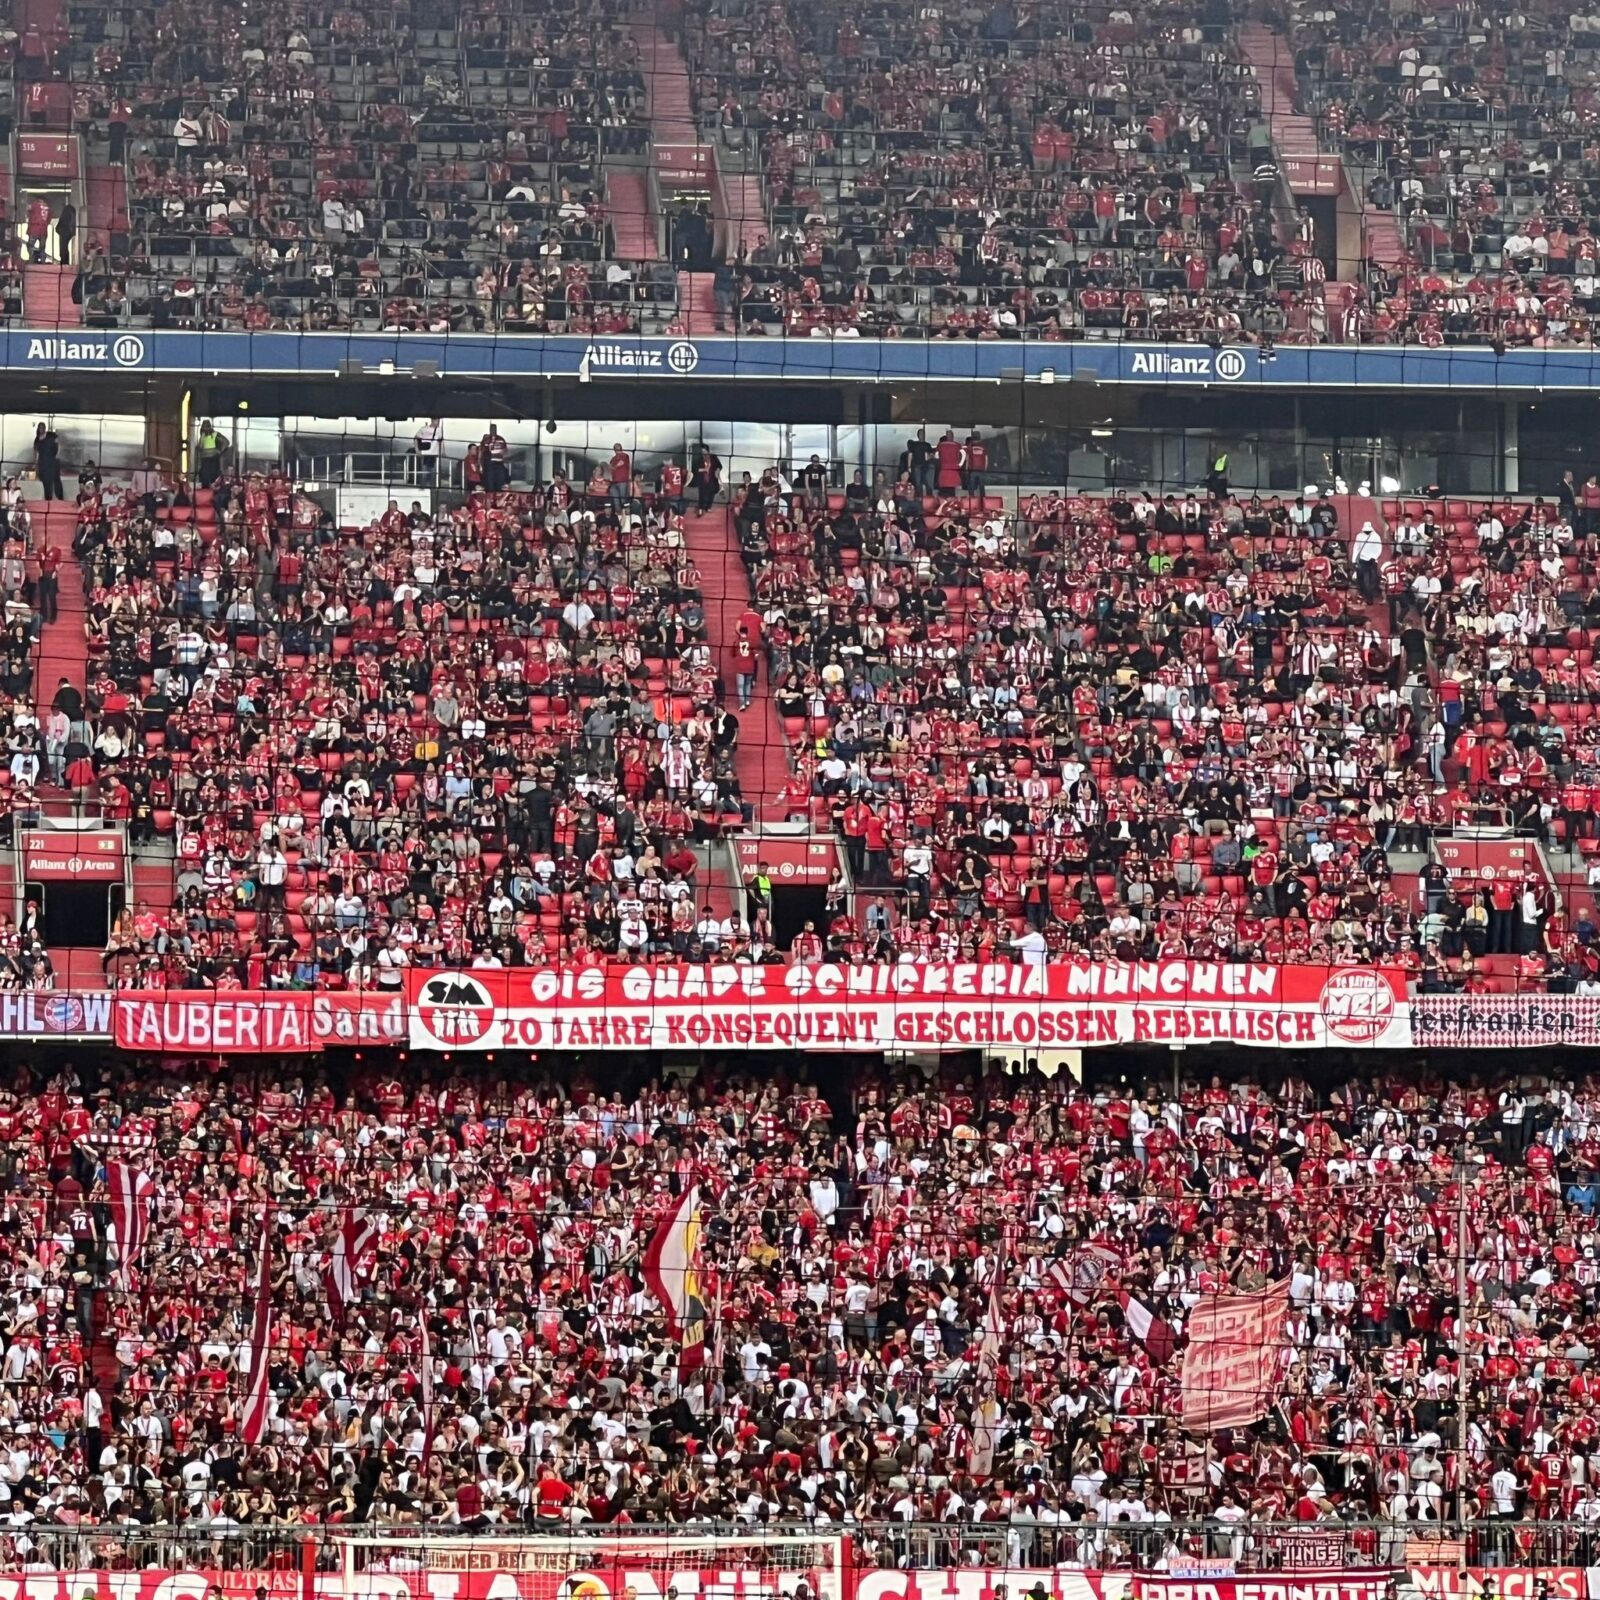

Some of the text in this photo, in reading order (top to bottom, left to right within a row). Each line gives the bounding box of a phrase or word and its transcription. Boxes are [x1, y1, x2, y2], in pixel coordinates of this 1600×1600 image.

[27, 339, 108, 360] Allianz
[1132, 353, 1210, 373] Allianz
[30, 840, 44, 850] 221
[742, 845, 758, 855] 220
[1444, 848, 1459, 858] 219
[30, 860, 115, 870] Allianz Arena
[796, 864, 827, 875] Arena
[785, 964, 1048, 996] SCHICKERIA
[1068, 961, 1277, 995] MÜNCHEN
[502, 1017, 542, 1045] 20
[553, 1016, 650, 1045] JAHRE
[666, 1012, 880, 1045] KONSEQUENT,
[1133, 1010, 1315, 1043] REBELLISCH
[1547, 1461, 1560, 1475] 19
